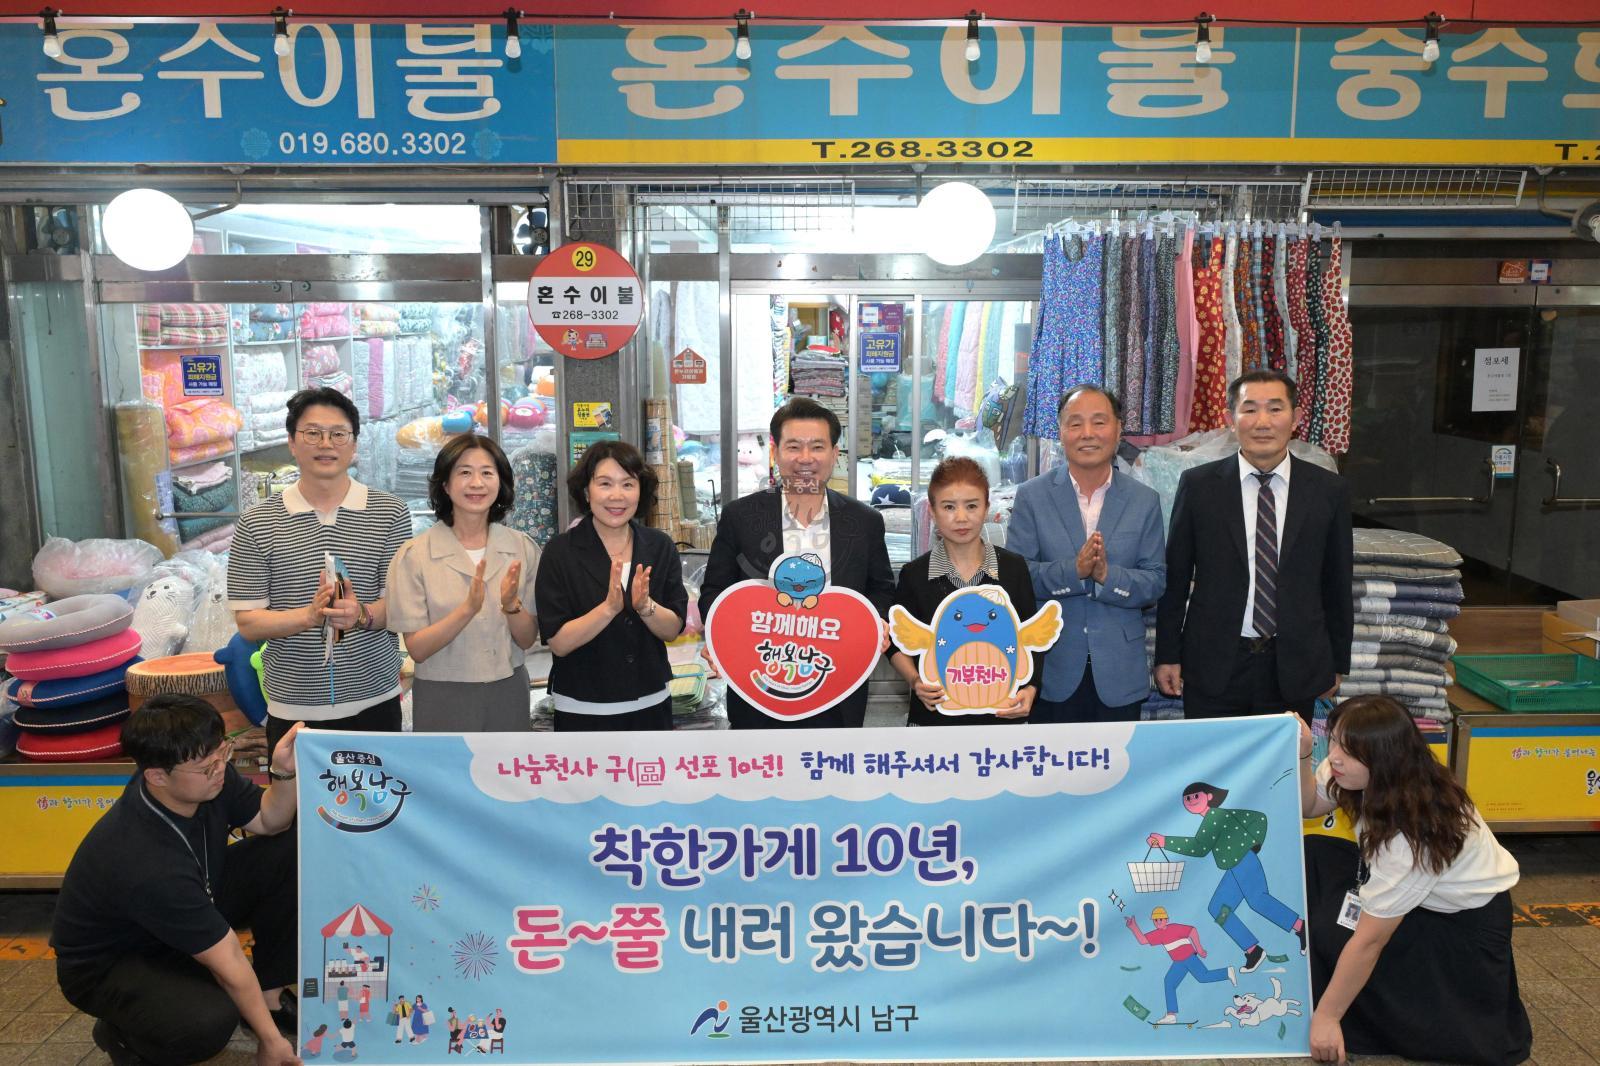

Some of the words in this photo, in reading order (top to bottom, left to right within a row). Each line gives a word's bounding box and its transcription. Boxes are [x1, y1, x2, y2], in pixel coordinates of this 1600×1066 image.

[36, 23, 503, 121] 혼수이불
[611, 25, 1236, 120] 혼수이불
[279, 132, 467, 156] 019.680.3302
[811, 140, 1034, 159] T.268.3302
[575, 250, 594, 267] 29
[562, 310, 619, 320] 268-3302
[865, 339, 895, 350] 고유가
[187, 362, 216, 373] 고유가
[750, 610, 841, 641] 함께해요
[757, 640, 833, 681] 행복남구
[946, 665, 1008, 685] 기부천사
[335, 753, 376, 765] 울산중심
[499, 753, 598, 785] 나눔천사
[675, 755, 721, 782] 선포
[728, 753, 784, 778] 10년!
[800, 751, 854, 781] 함께
[864, 751, 959, 778] 해주셔서
[969, 745, 1110, 777] 감사합니다!
[319, 769, 412, 811] 행복남구
[594, 826, 816, 887] 착한가게
[836, 824, 975, 882] 10년,
[510, 905, 666, 970] 돈~쭐
[683, 905, 792, 960] 내러
[810, 901, 1097, 968] 왔습니다~!
[739, 1005, 860, 1033] 울산광역시
[871, 1004, 919, 1033] 남구
